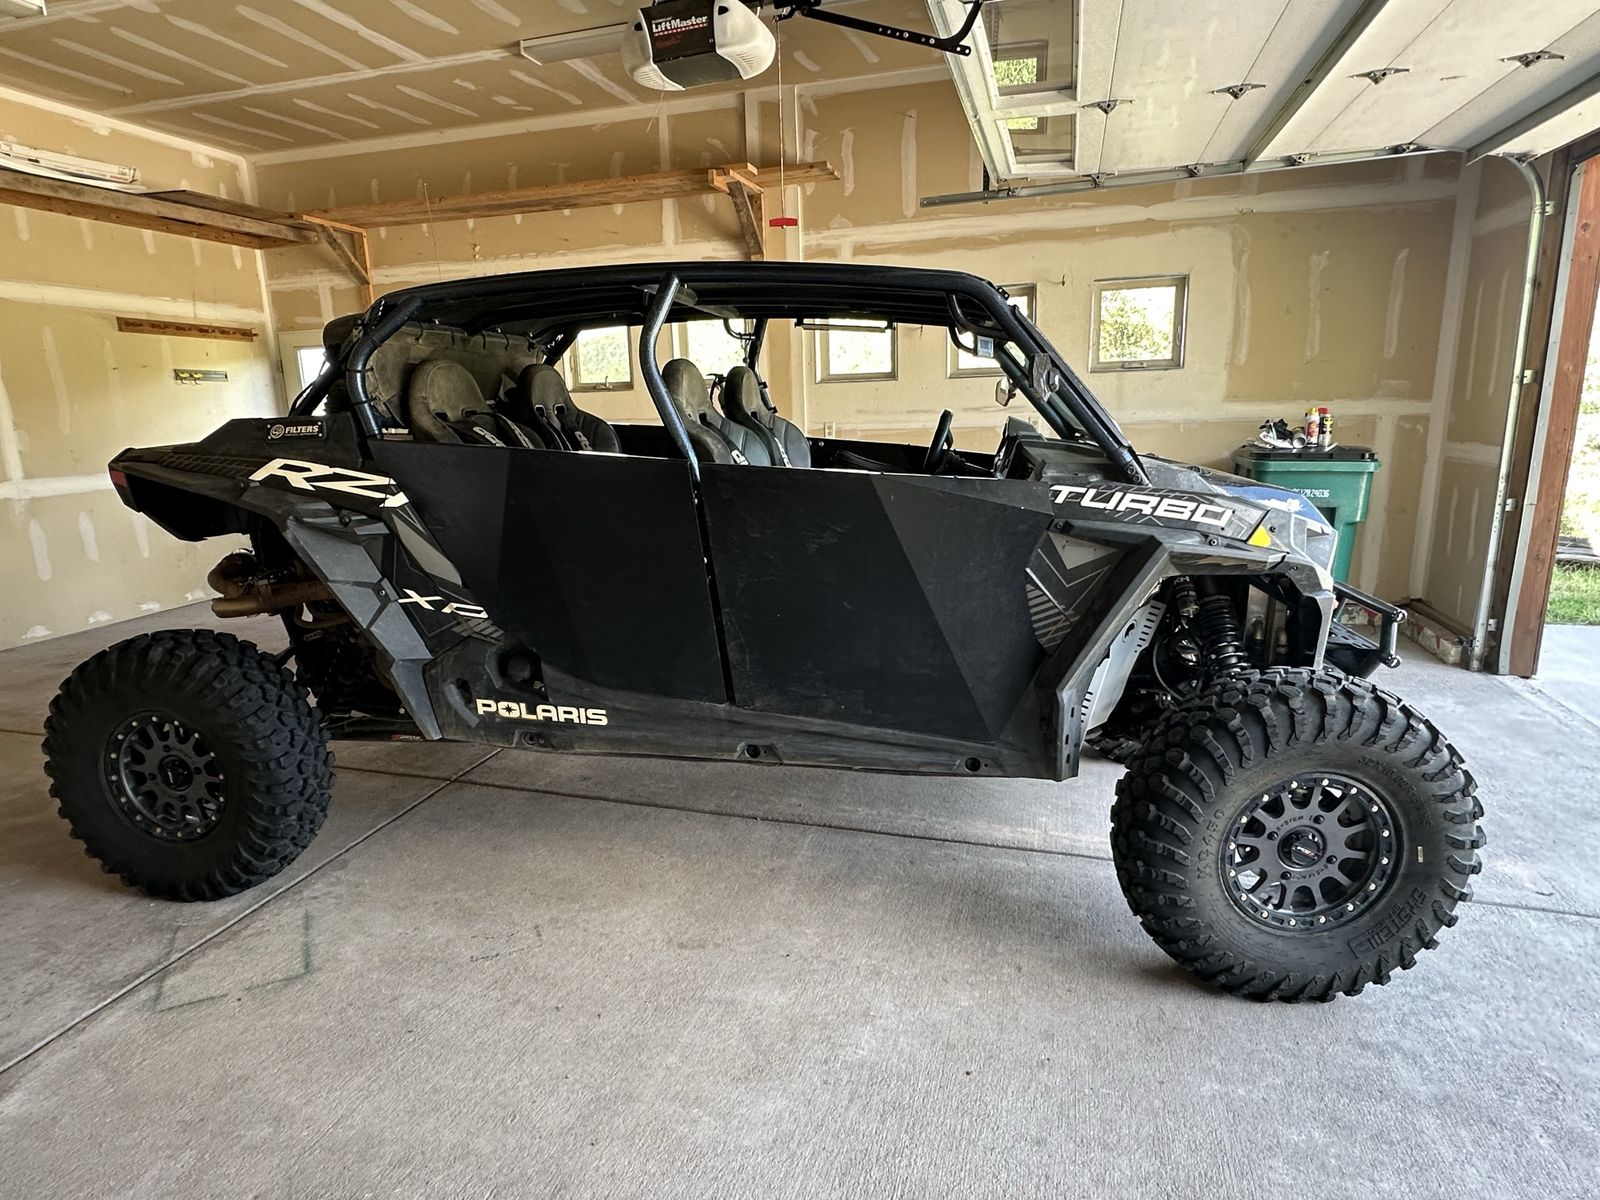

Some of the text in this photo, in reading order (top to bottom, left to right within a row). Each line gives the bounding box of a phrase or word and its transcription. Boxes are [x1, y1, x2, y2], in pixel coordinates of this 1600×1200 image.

[652, 16, 708, 33] LiftMaster
[285, 425, 319, 434] FILTERS
[1050, 484, 1233, 527] TURBO
[475, 698, 608, 726] POLARIS
